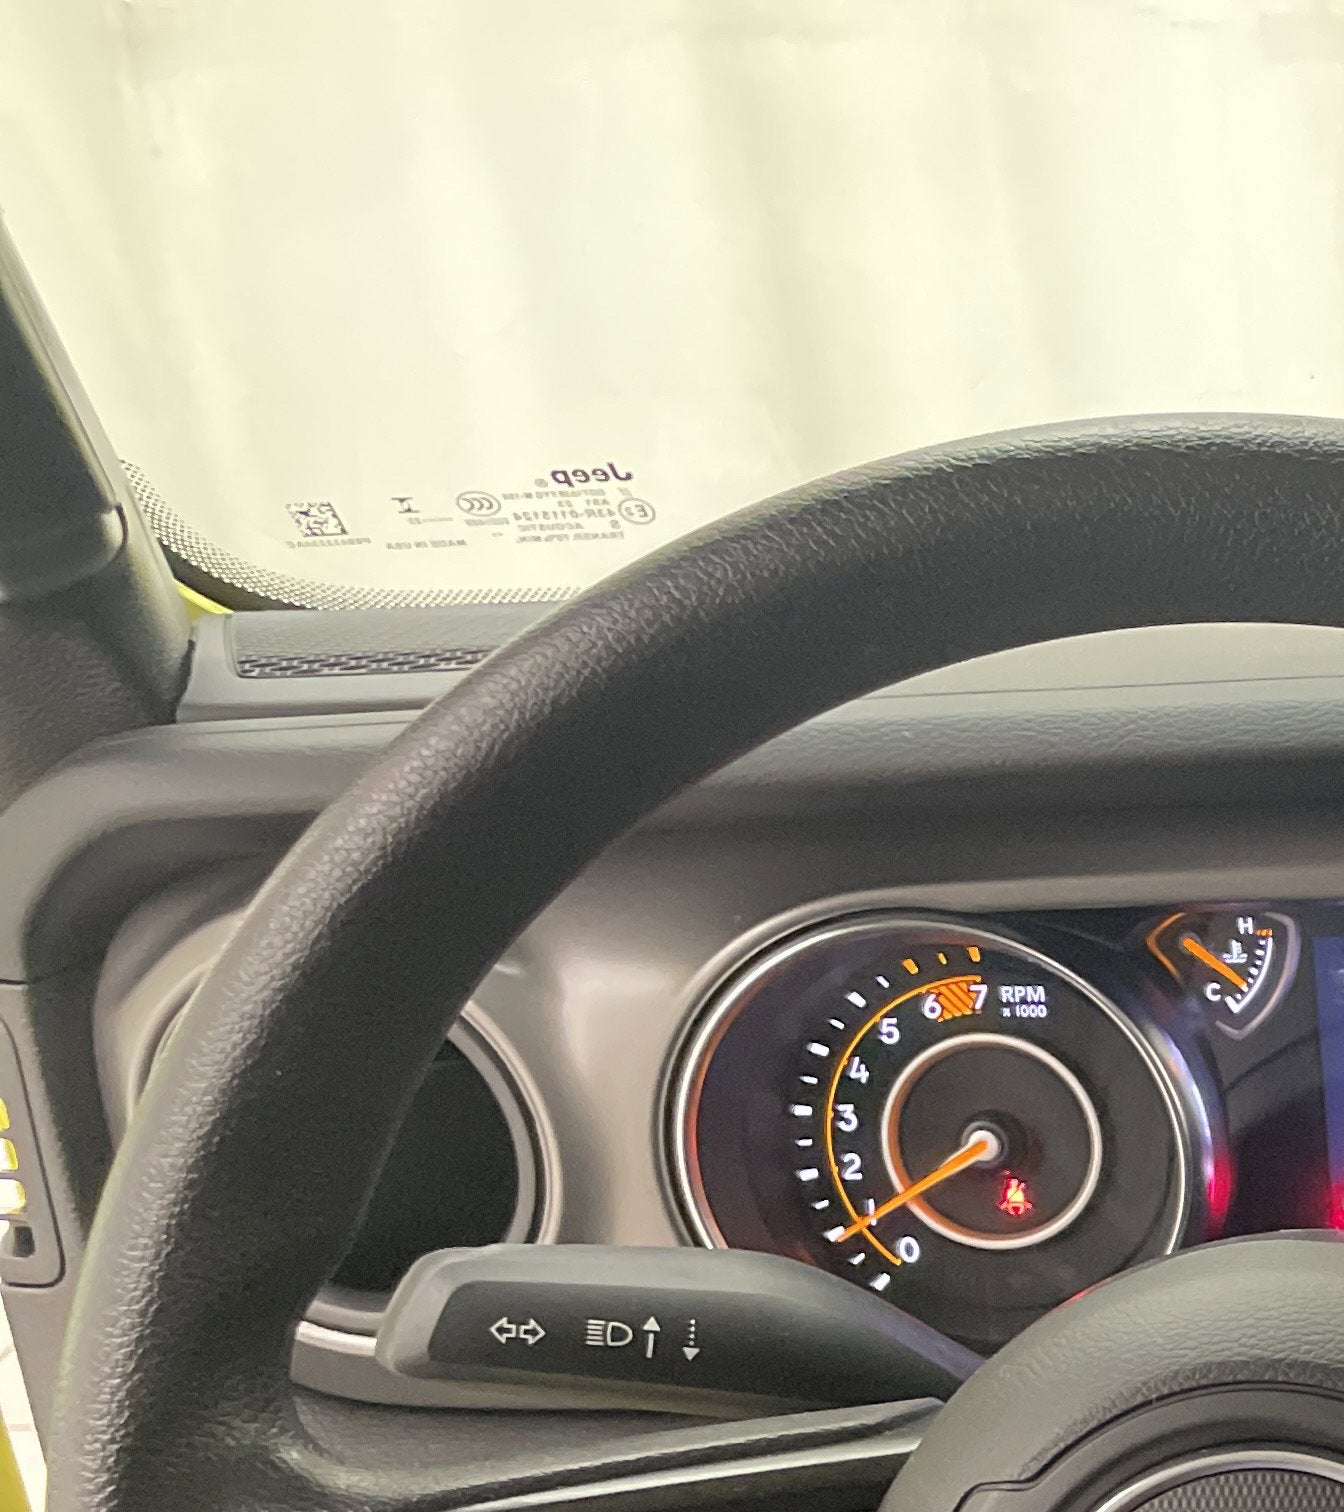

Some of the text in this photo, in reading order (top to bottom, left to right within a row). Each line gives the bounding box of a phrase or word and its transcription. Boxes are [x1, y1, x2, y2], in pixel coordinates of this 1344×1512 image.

[1238, 917, 1254, 935] H
[922, 993, 941, 1019] 6
[969, 984, 987, 1010] 7
[1000, 985, 1046, 1003] RPM
[1204, 984, 1222, 1003] C
[1016, 1005, 1047, 1018] 1000
[879, 1017, 900, 1045] 5
[849, 1056, 869, 1084] 4
[837, 1104, 858, 1132] 3
[842, 1153, 863, 1181] 2
[897, 1235, 920, 1264] 0
